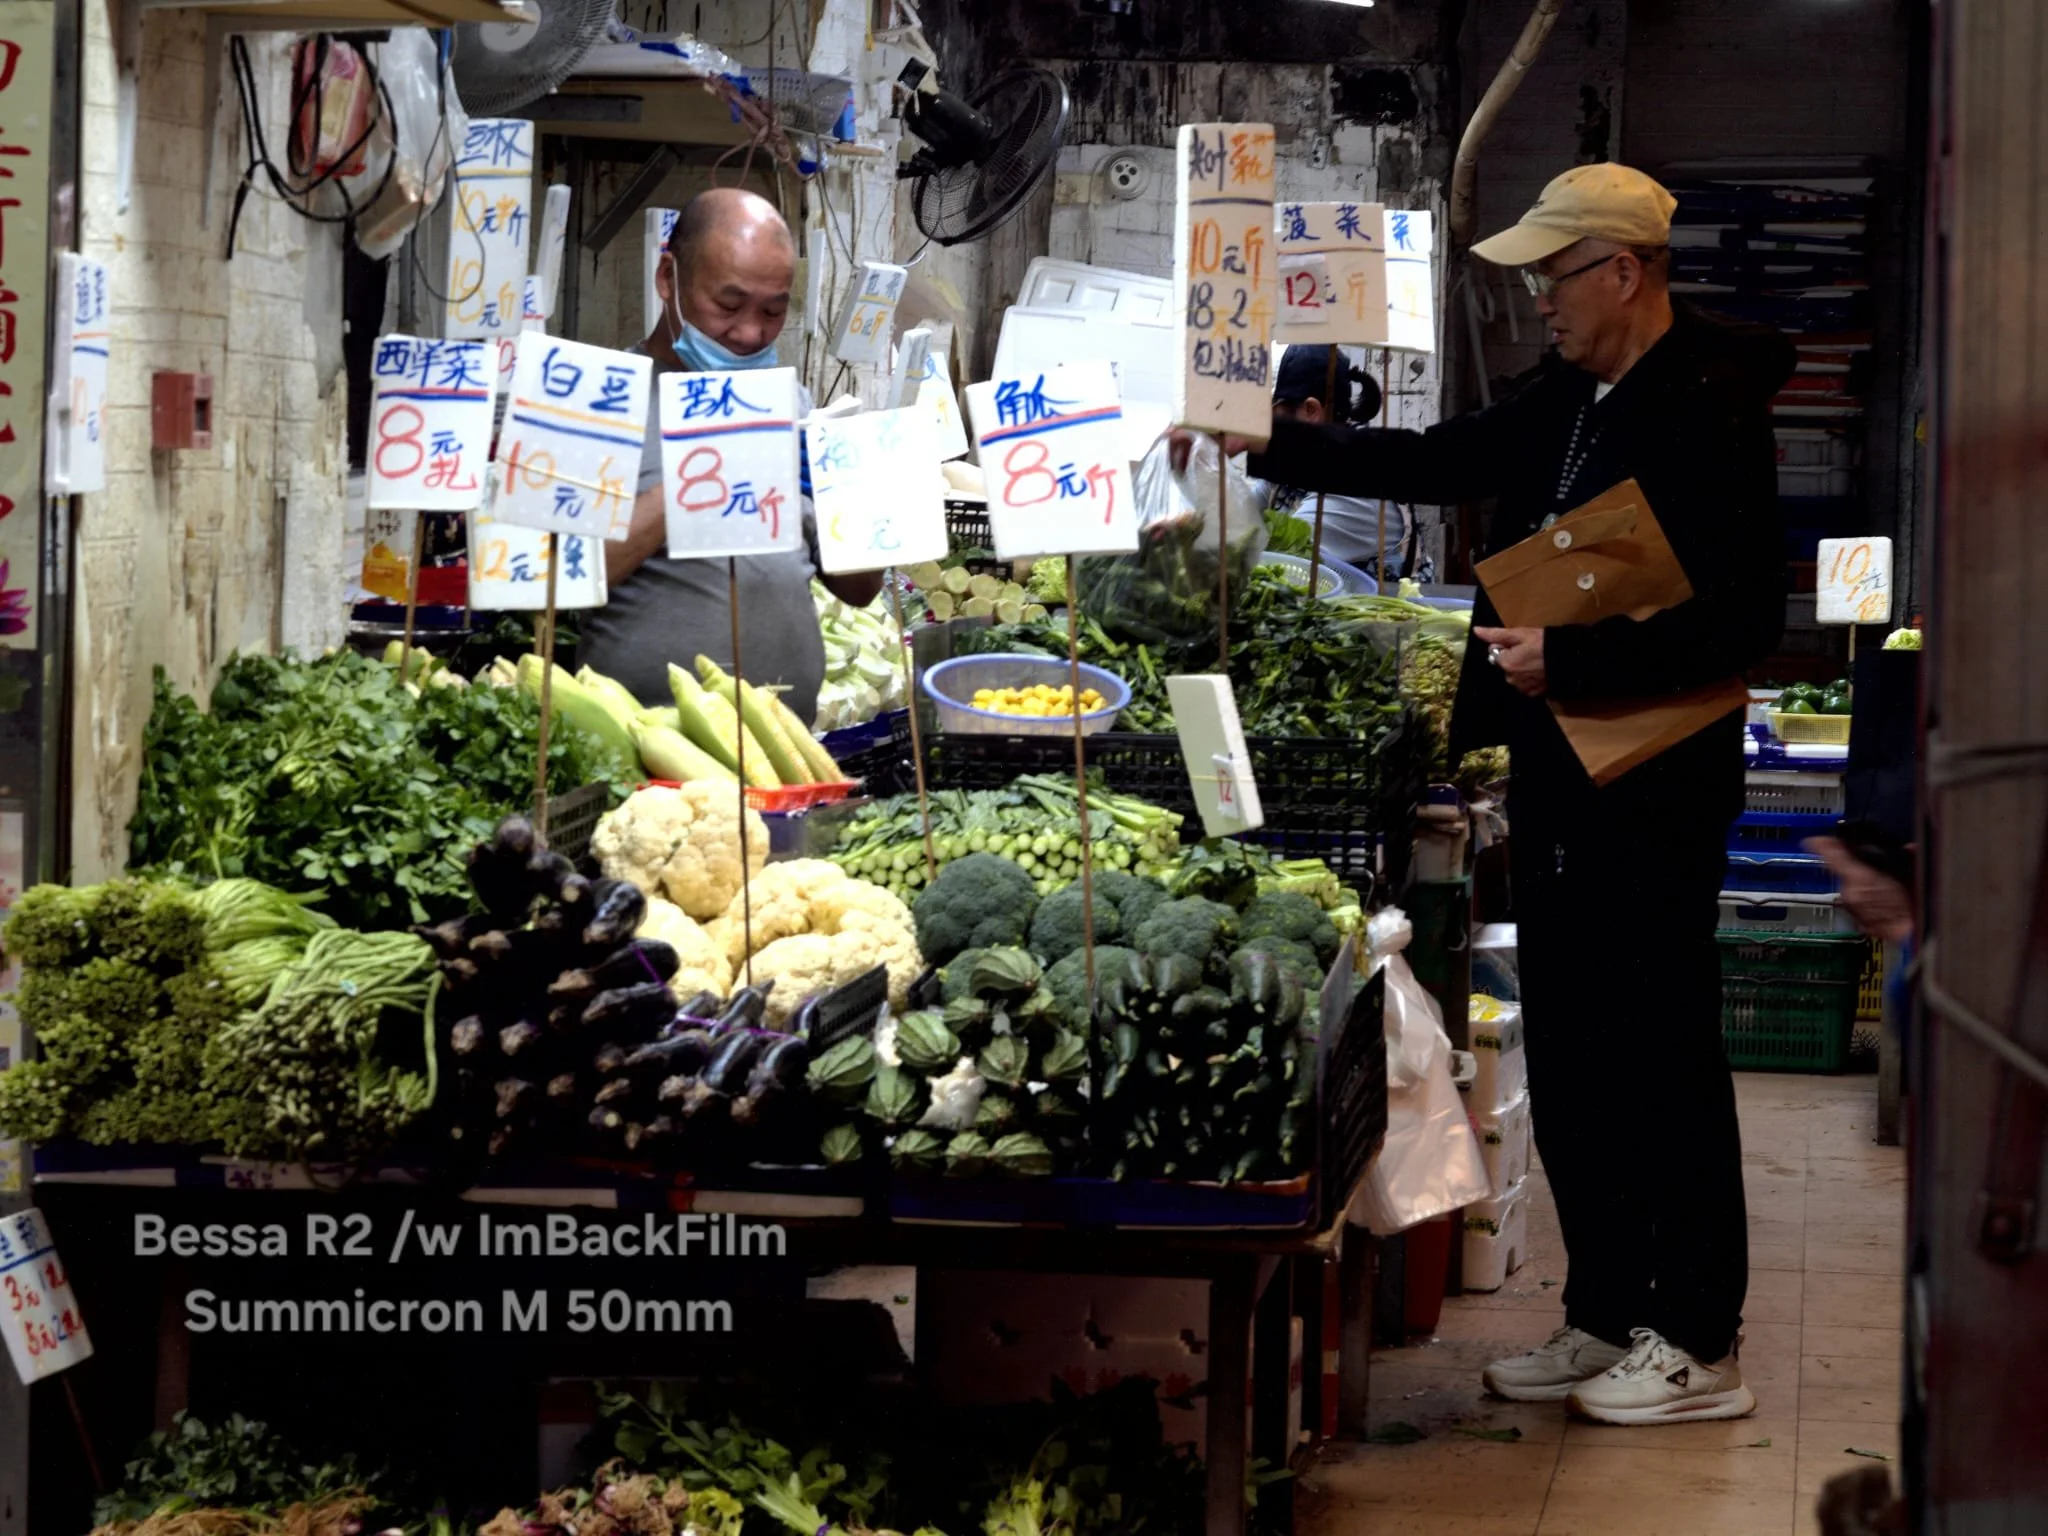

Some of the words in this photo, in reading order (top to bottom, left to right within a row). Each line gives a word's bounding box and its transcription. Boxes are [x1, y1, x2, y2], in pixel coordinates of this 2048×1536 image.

[375, 340, 491, 390] 西洋菜
[541, 346, 638, 414] 白豆
[677, 446, 786, 540] 8元斤
[1003, 440, 1118, 526] 8元斤
